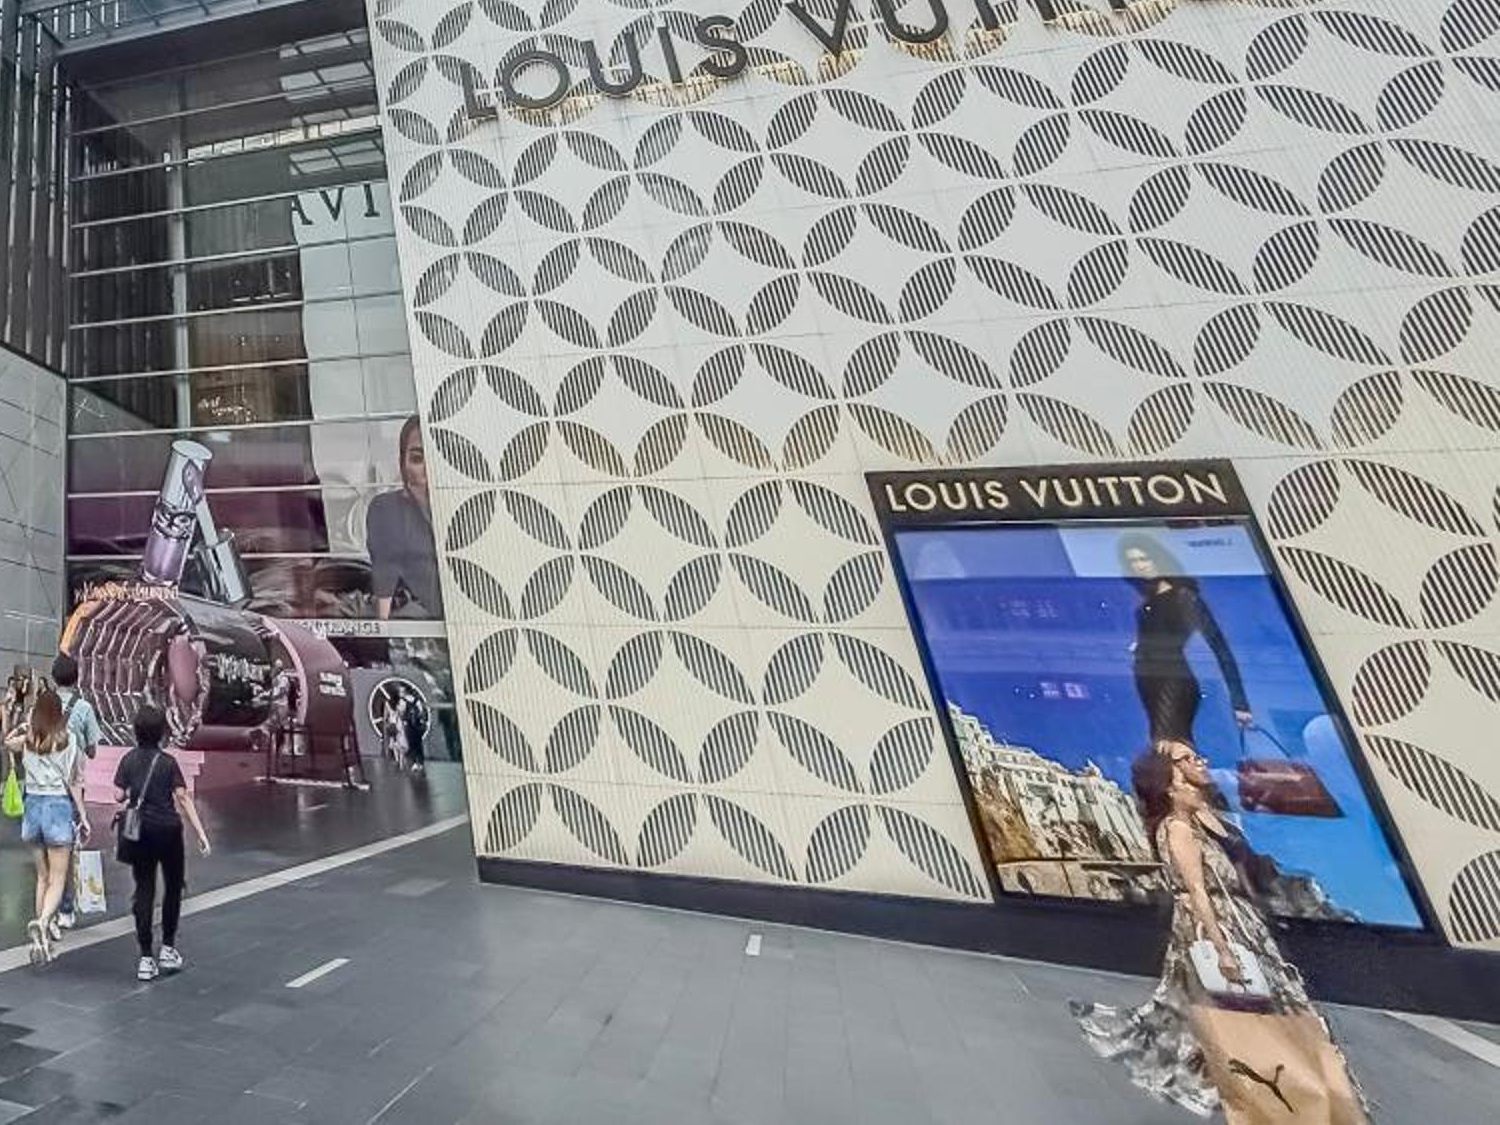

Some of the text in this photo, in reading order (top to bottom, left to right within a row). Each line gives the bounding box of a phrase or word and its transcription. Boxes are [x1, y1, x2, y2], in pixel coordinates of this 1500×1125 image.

[462, 15, 749, 120] LOUIS
[884, 473, 1228, 512] LOUIS VUITTON
